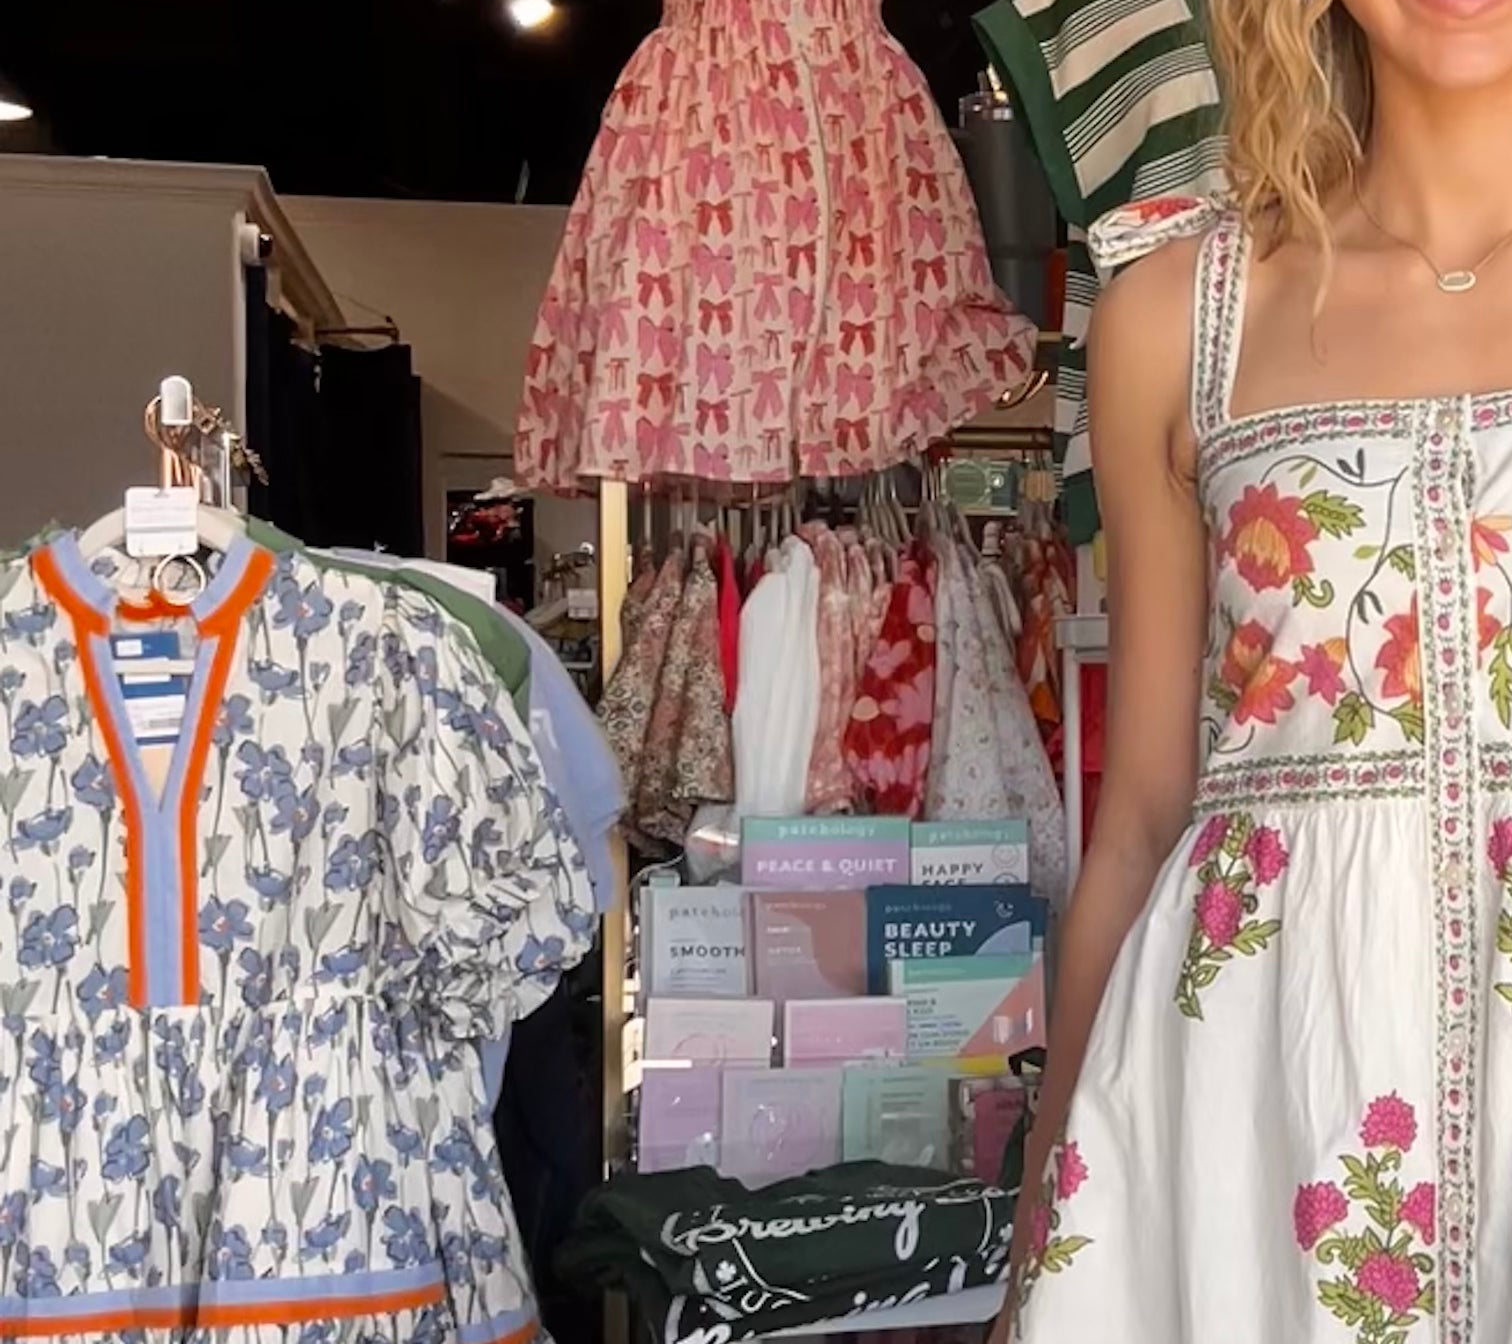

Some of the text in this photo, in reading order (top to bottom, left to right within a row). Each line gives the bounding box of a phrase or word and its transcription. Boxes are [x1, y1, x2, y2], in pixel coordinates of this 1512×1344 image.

[756, 858, 897, 876] PEACE & QUIET
[922, 863, 984, 876] HAPPY
[883, 921, 977, 939] BEAUTY
[669, 945, 746, 959] SMOOTH
[883, 941, 953, 958] SLEEP
